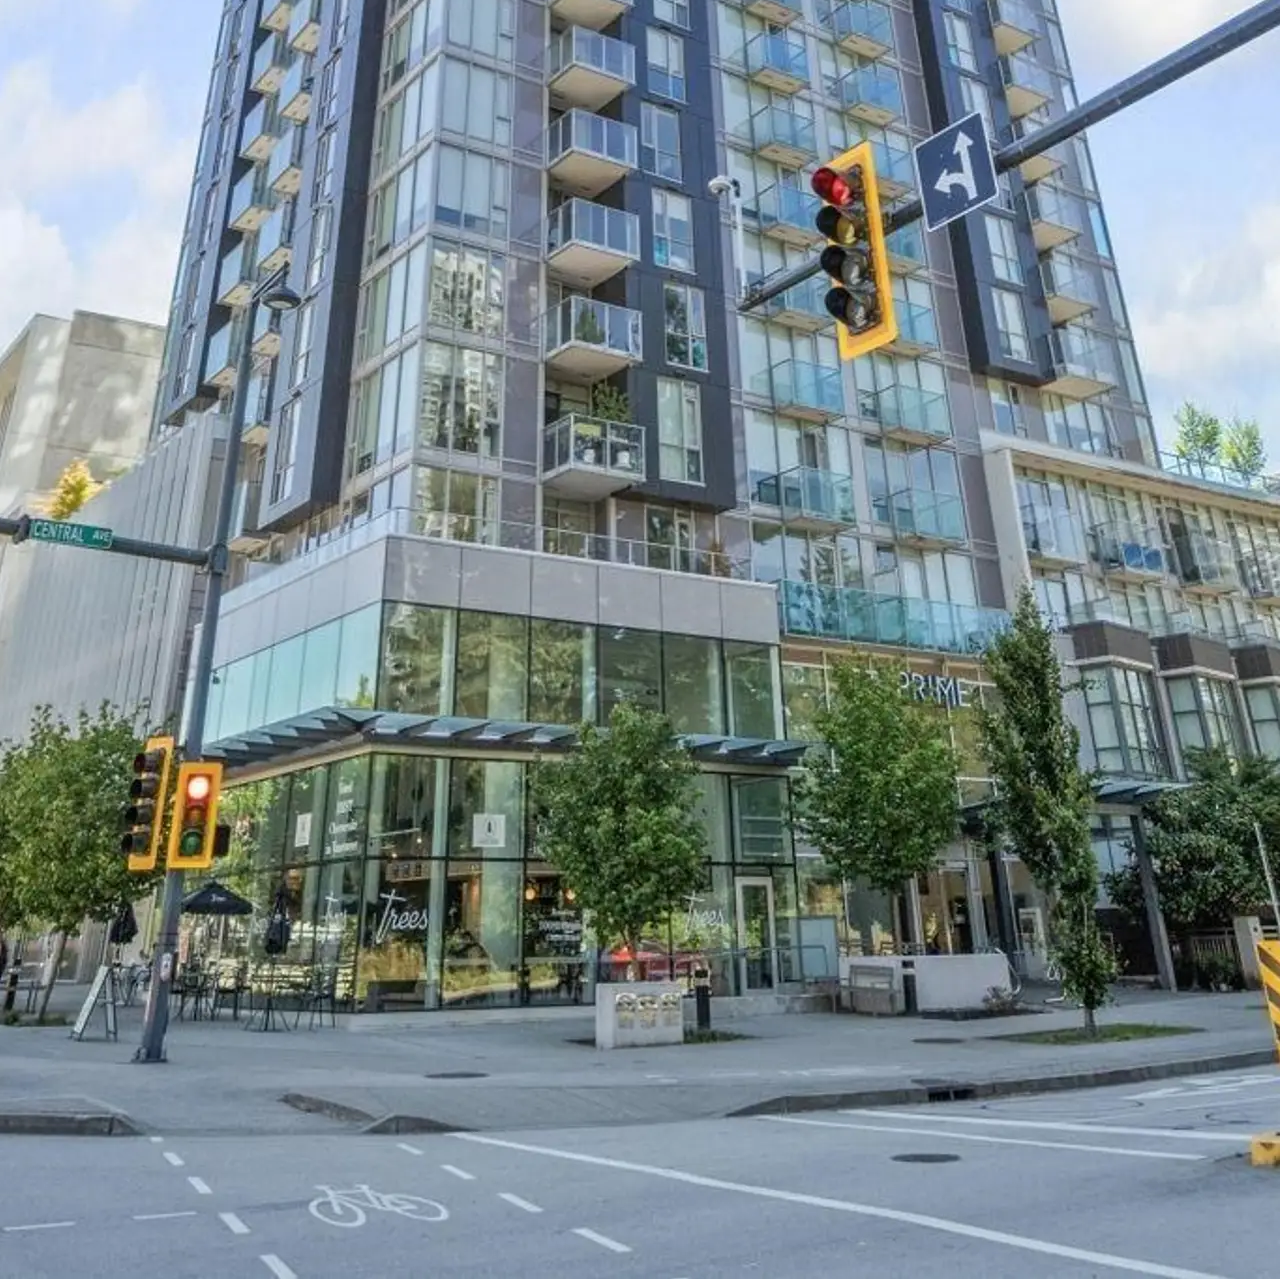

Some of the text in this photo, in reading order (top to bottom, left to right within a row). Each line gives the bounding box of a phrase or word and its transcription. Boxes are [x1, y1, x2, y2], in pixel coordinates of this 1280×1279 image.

[34, 521, 84, 542] CENTRAL
[899, 671, 972, 708] PRIME
[375, 888, 428, 945] Trees
